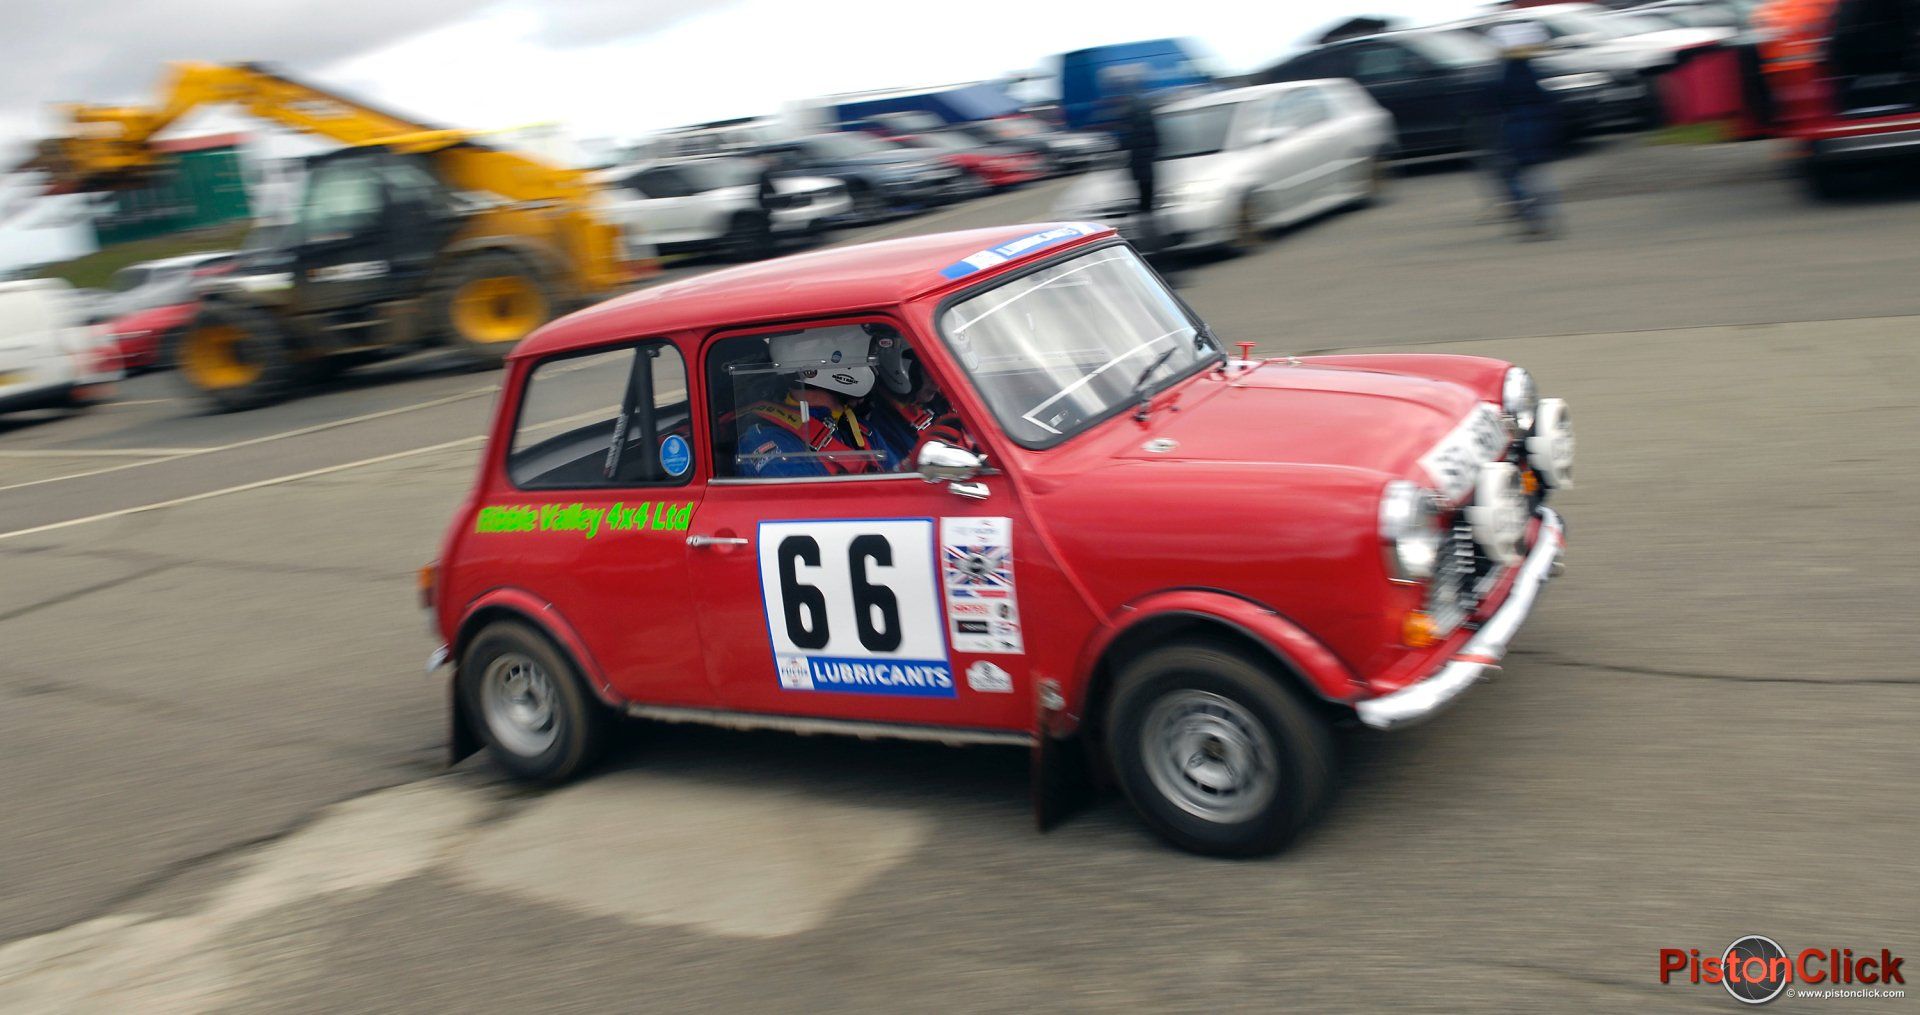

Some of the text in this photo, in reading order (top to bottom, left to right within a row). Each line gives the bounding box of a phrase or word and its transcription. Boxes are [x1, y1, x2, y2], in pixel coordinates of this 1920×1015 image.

[540, 502, 605, 539] Valley
[606, 502, 650, 530] 4x4
[651, 502, 694, 531] Ltd
[778, 534, 902, 652] 66
[813, 661, 952, 688] LUBRICANTS
